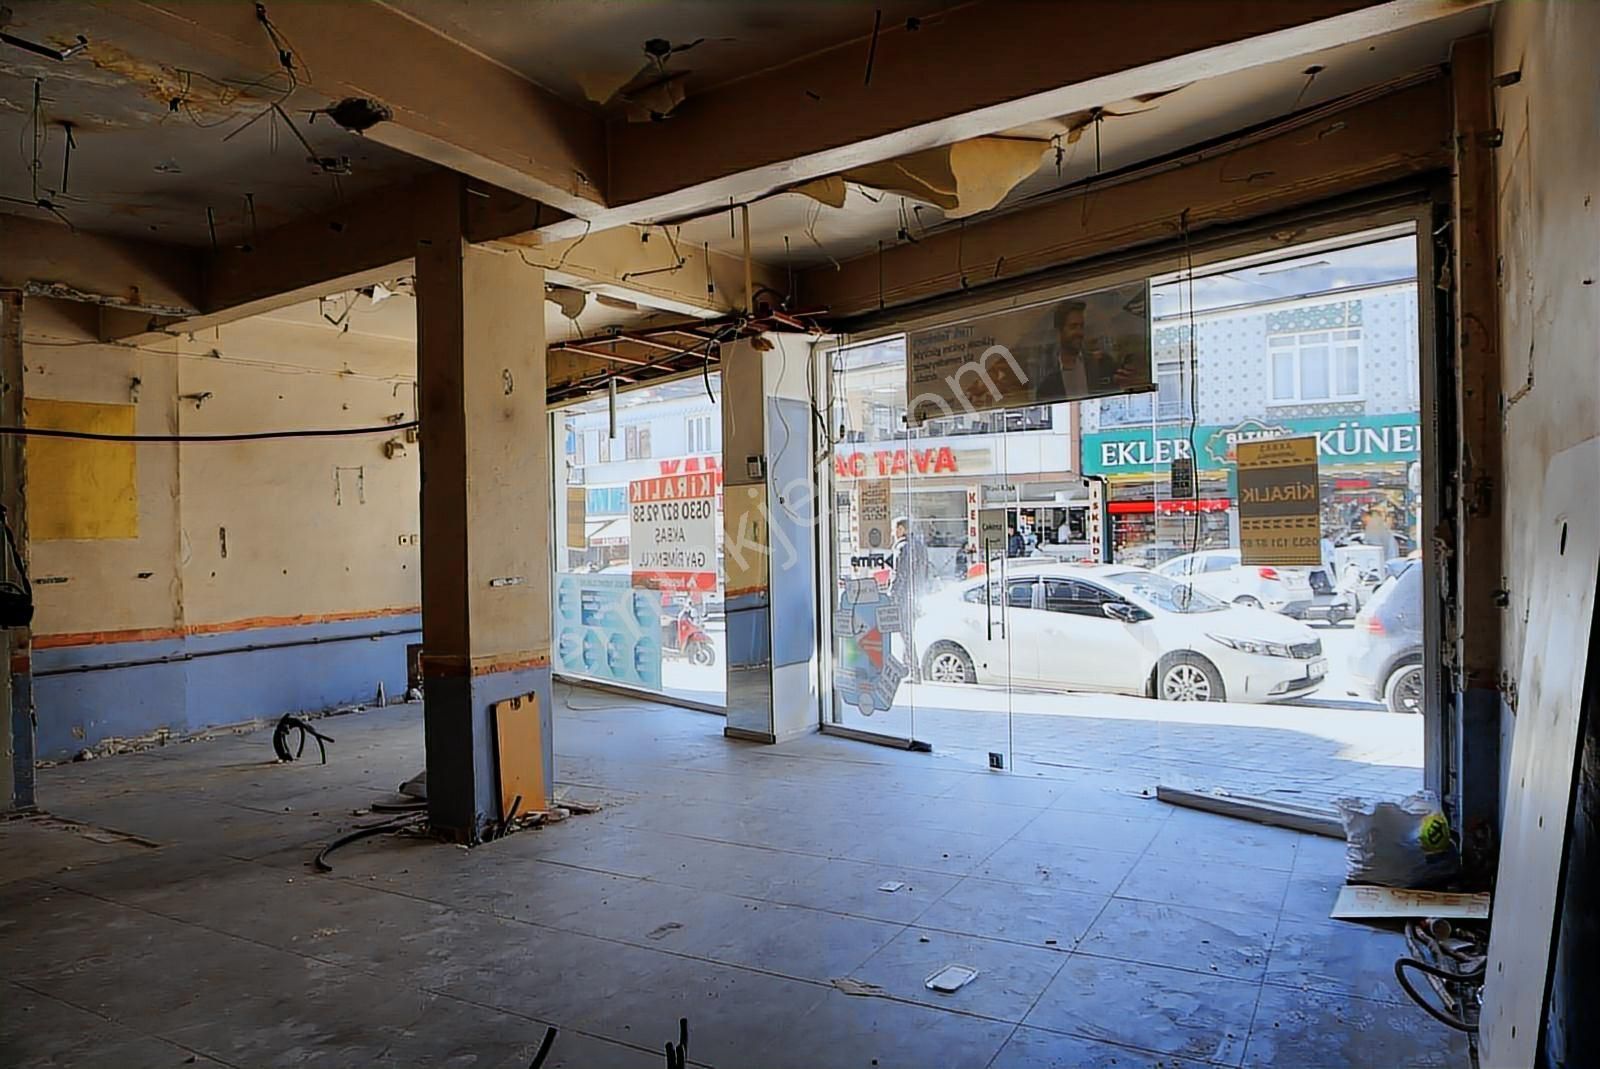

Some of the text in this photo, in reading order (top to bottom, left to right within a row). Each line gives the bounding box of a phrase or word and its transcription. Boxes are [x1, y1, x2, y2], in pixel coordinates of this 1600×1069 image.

[1101, 439, 1191, 466] EKLER
[1316, 422, 1421, 456] KÜNE
[873, 446, 958, 476] TAVA
